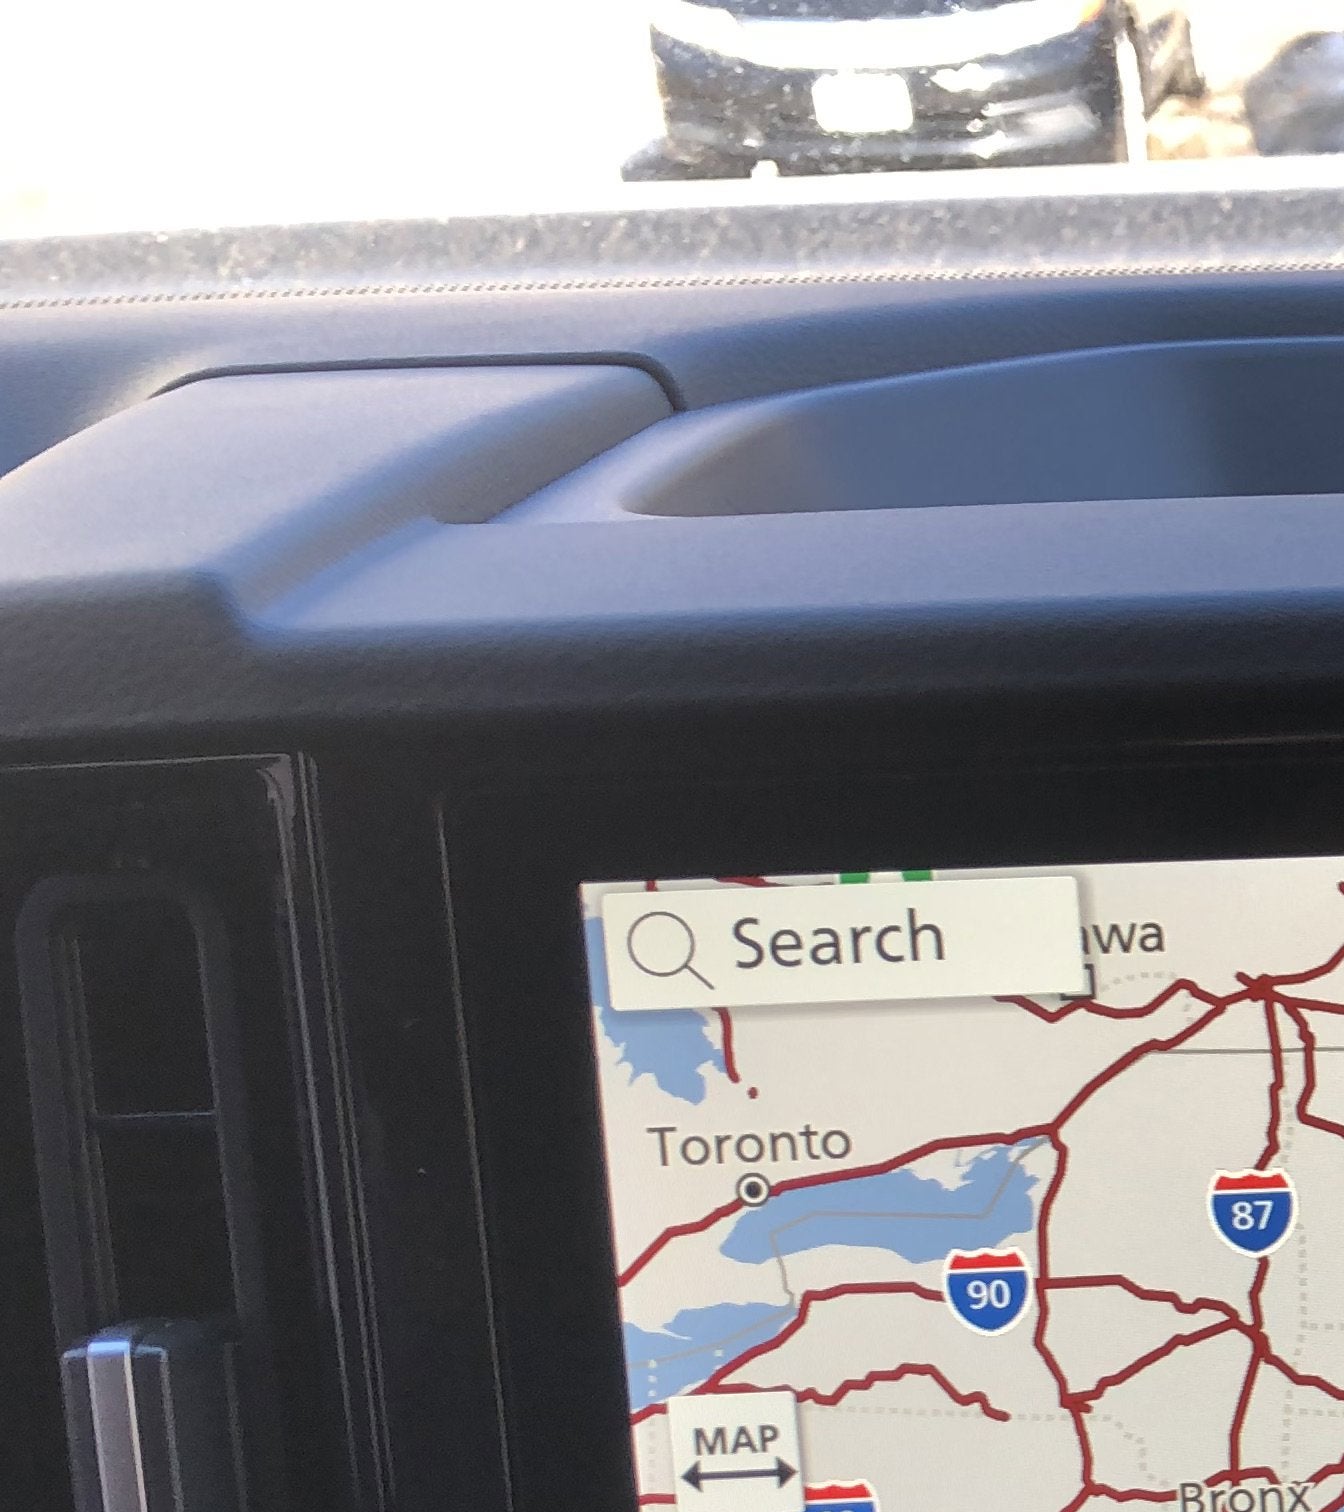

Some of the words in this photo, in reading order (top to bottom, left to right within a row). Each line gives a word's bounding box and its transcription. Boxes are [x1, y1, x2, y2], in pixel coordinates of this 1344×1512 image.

[732, 908, 946, 971] Search
[646, 1124, 852, 1168] Toronto
[1232, 1203, 1273, 1231] 87
[968, 1281, 1011, 1310] 90
[693, 1426, 780, 1457] MAP
